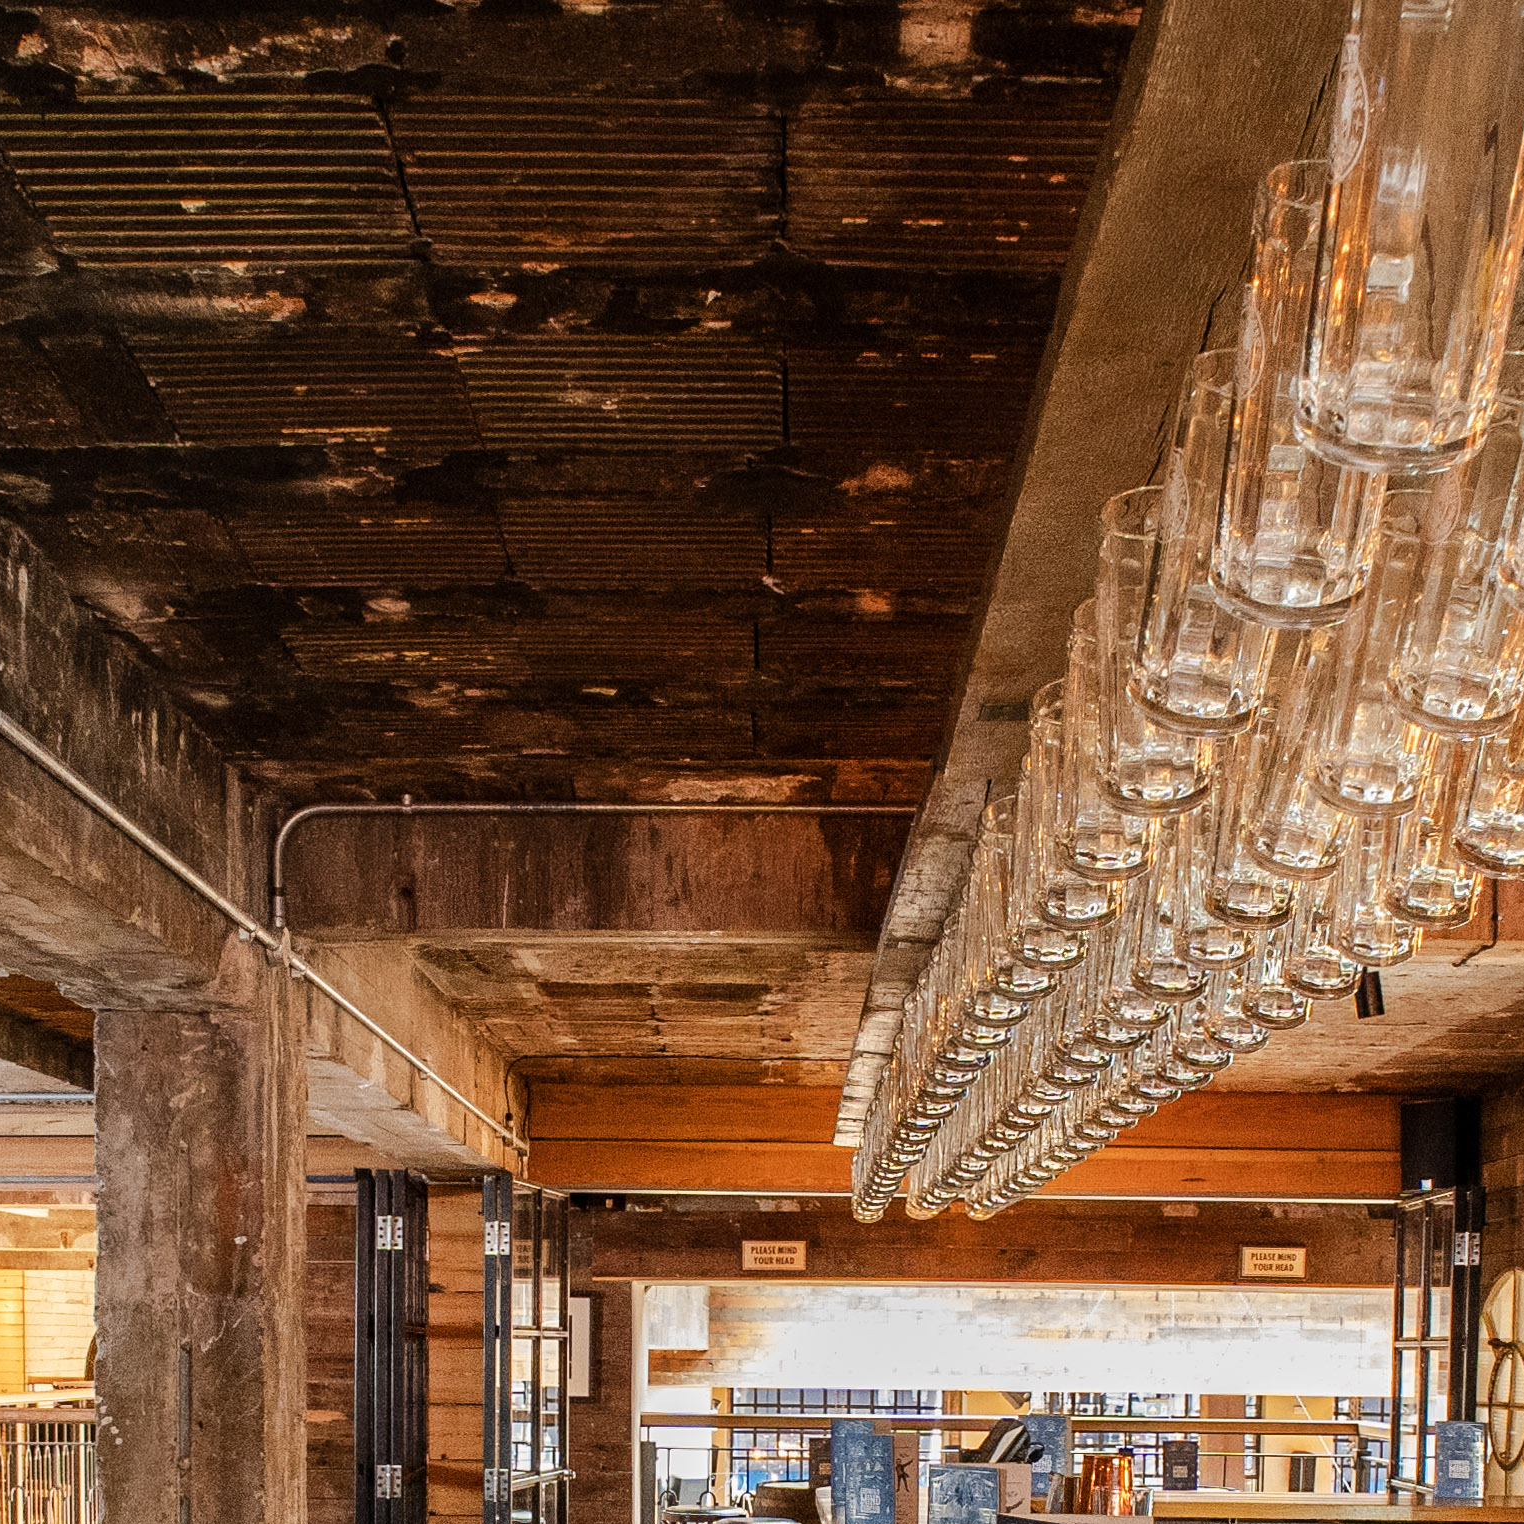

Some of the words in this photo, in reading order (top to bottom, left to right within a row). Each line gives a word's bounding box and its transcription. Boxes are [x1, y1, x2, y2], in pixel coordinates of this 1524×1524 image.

[751, 1246, 776, 1254] PLEASE
[778, 1246, 798, 1254] MIND
[754, 1256, 774, 1265] YOUR
[776, 1256, 795, 1265] HEAD
[1251, 1252, 1276, 1261] PLEASE
[1277, 1253, 1297, 1261] MIND
[1253, 1263, 1274, 1271] YOUR
[1275, 1263, 1294, 1271] HEAD
